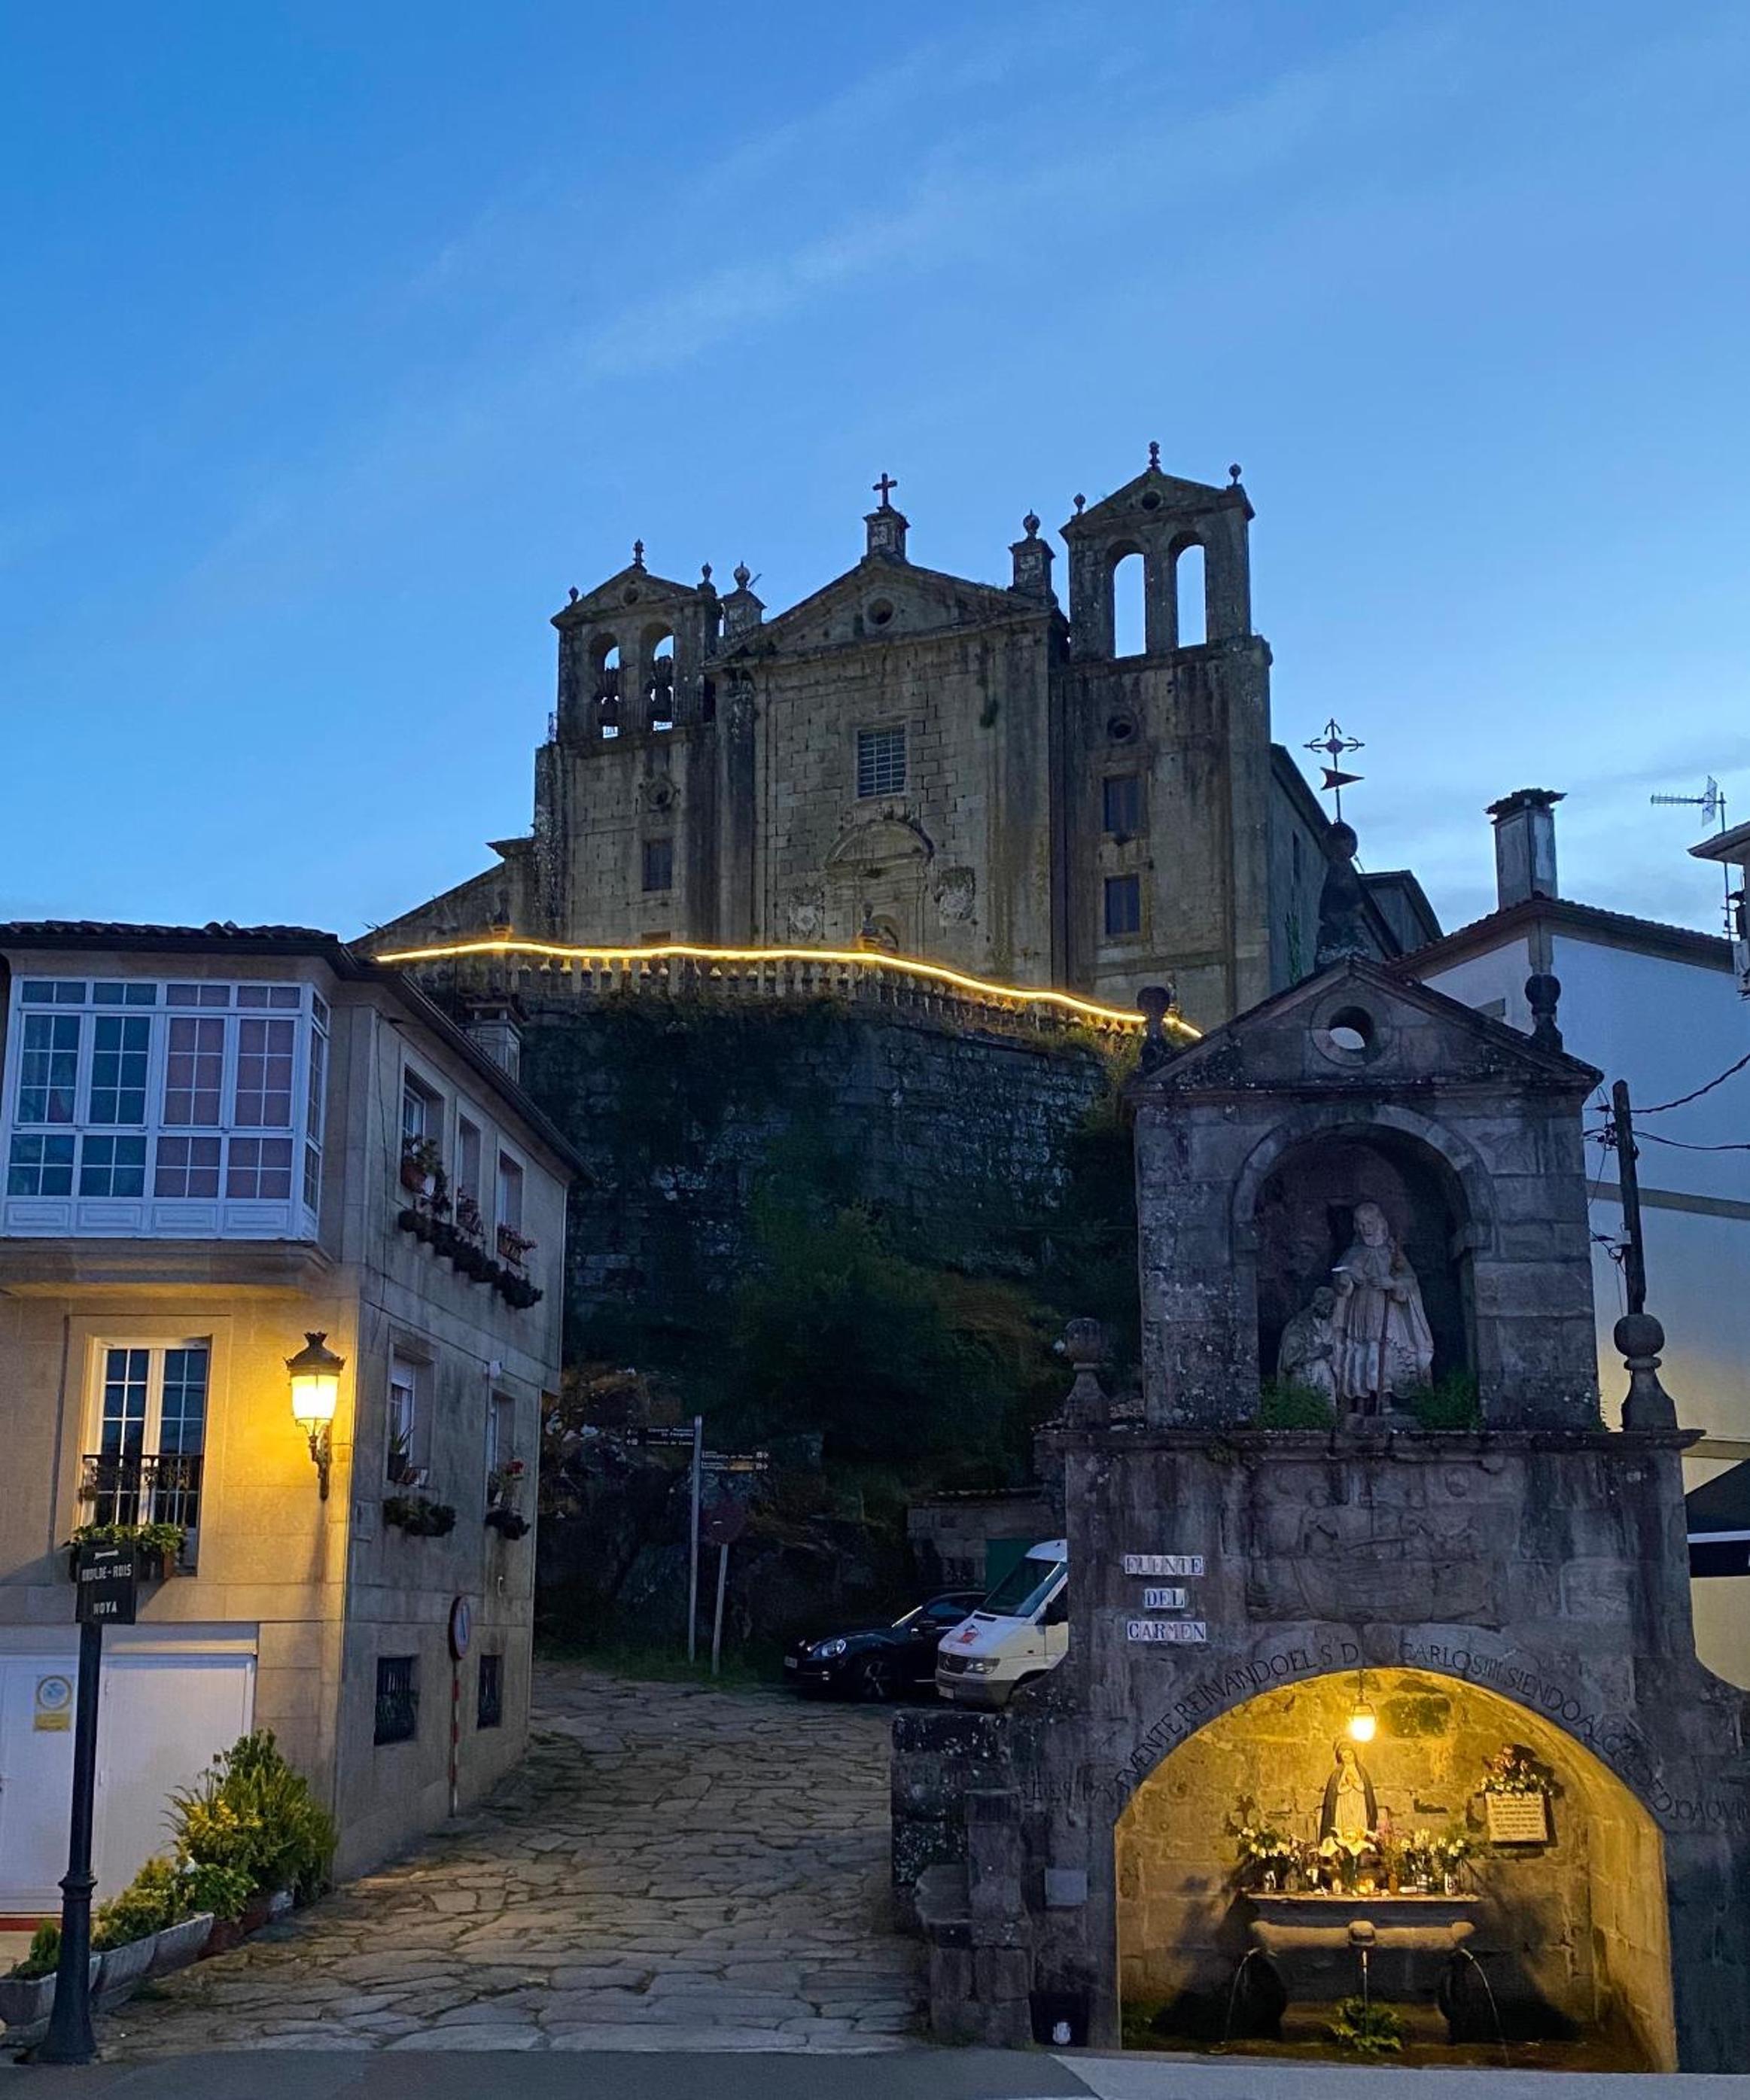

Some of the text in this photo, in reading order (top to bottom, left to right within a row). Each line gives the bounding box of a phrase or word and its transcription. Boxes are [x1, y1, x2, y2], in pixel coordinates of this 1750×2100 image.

[1126, 1557, 1202, 1574] FUENTE
[1147, 1590, 1184, 1606] DEL
[1129, 1623, 1205, 1639] CARMEN
